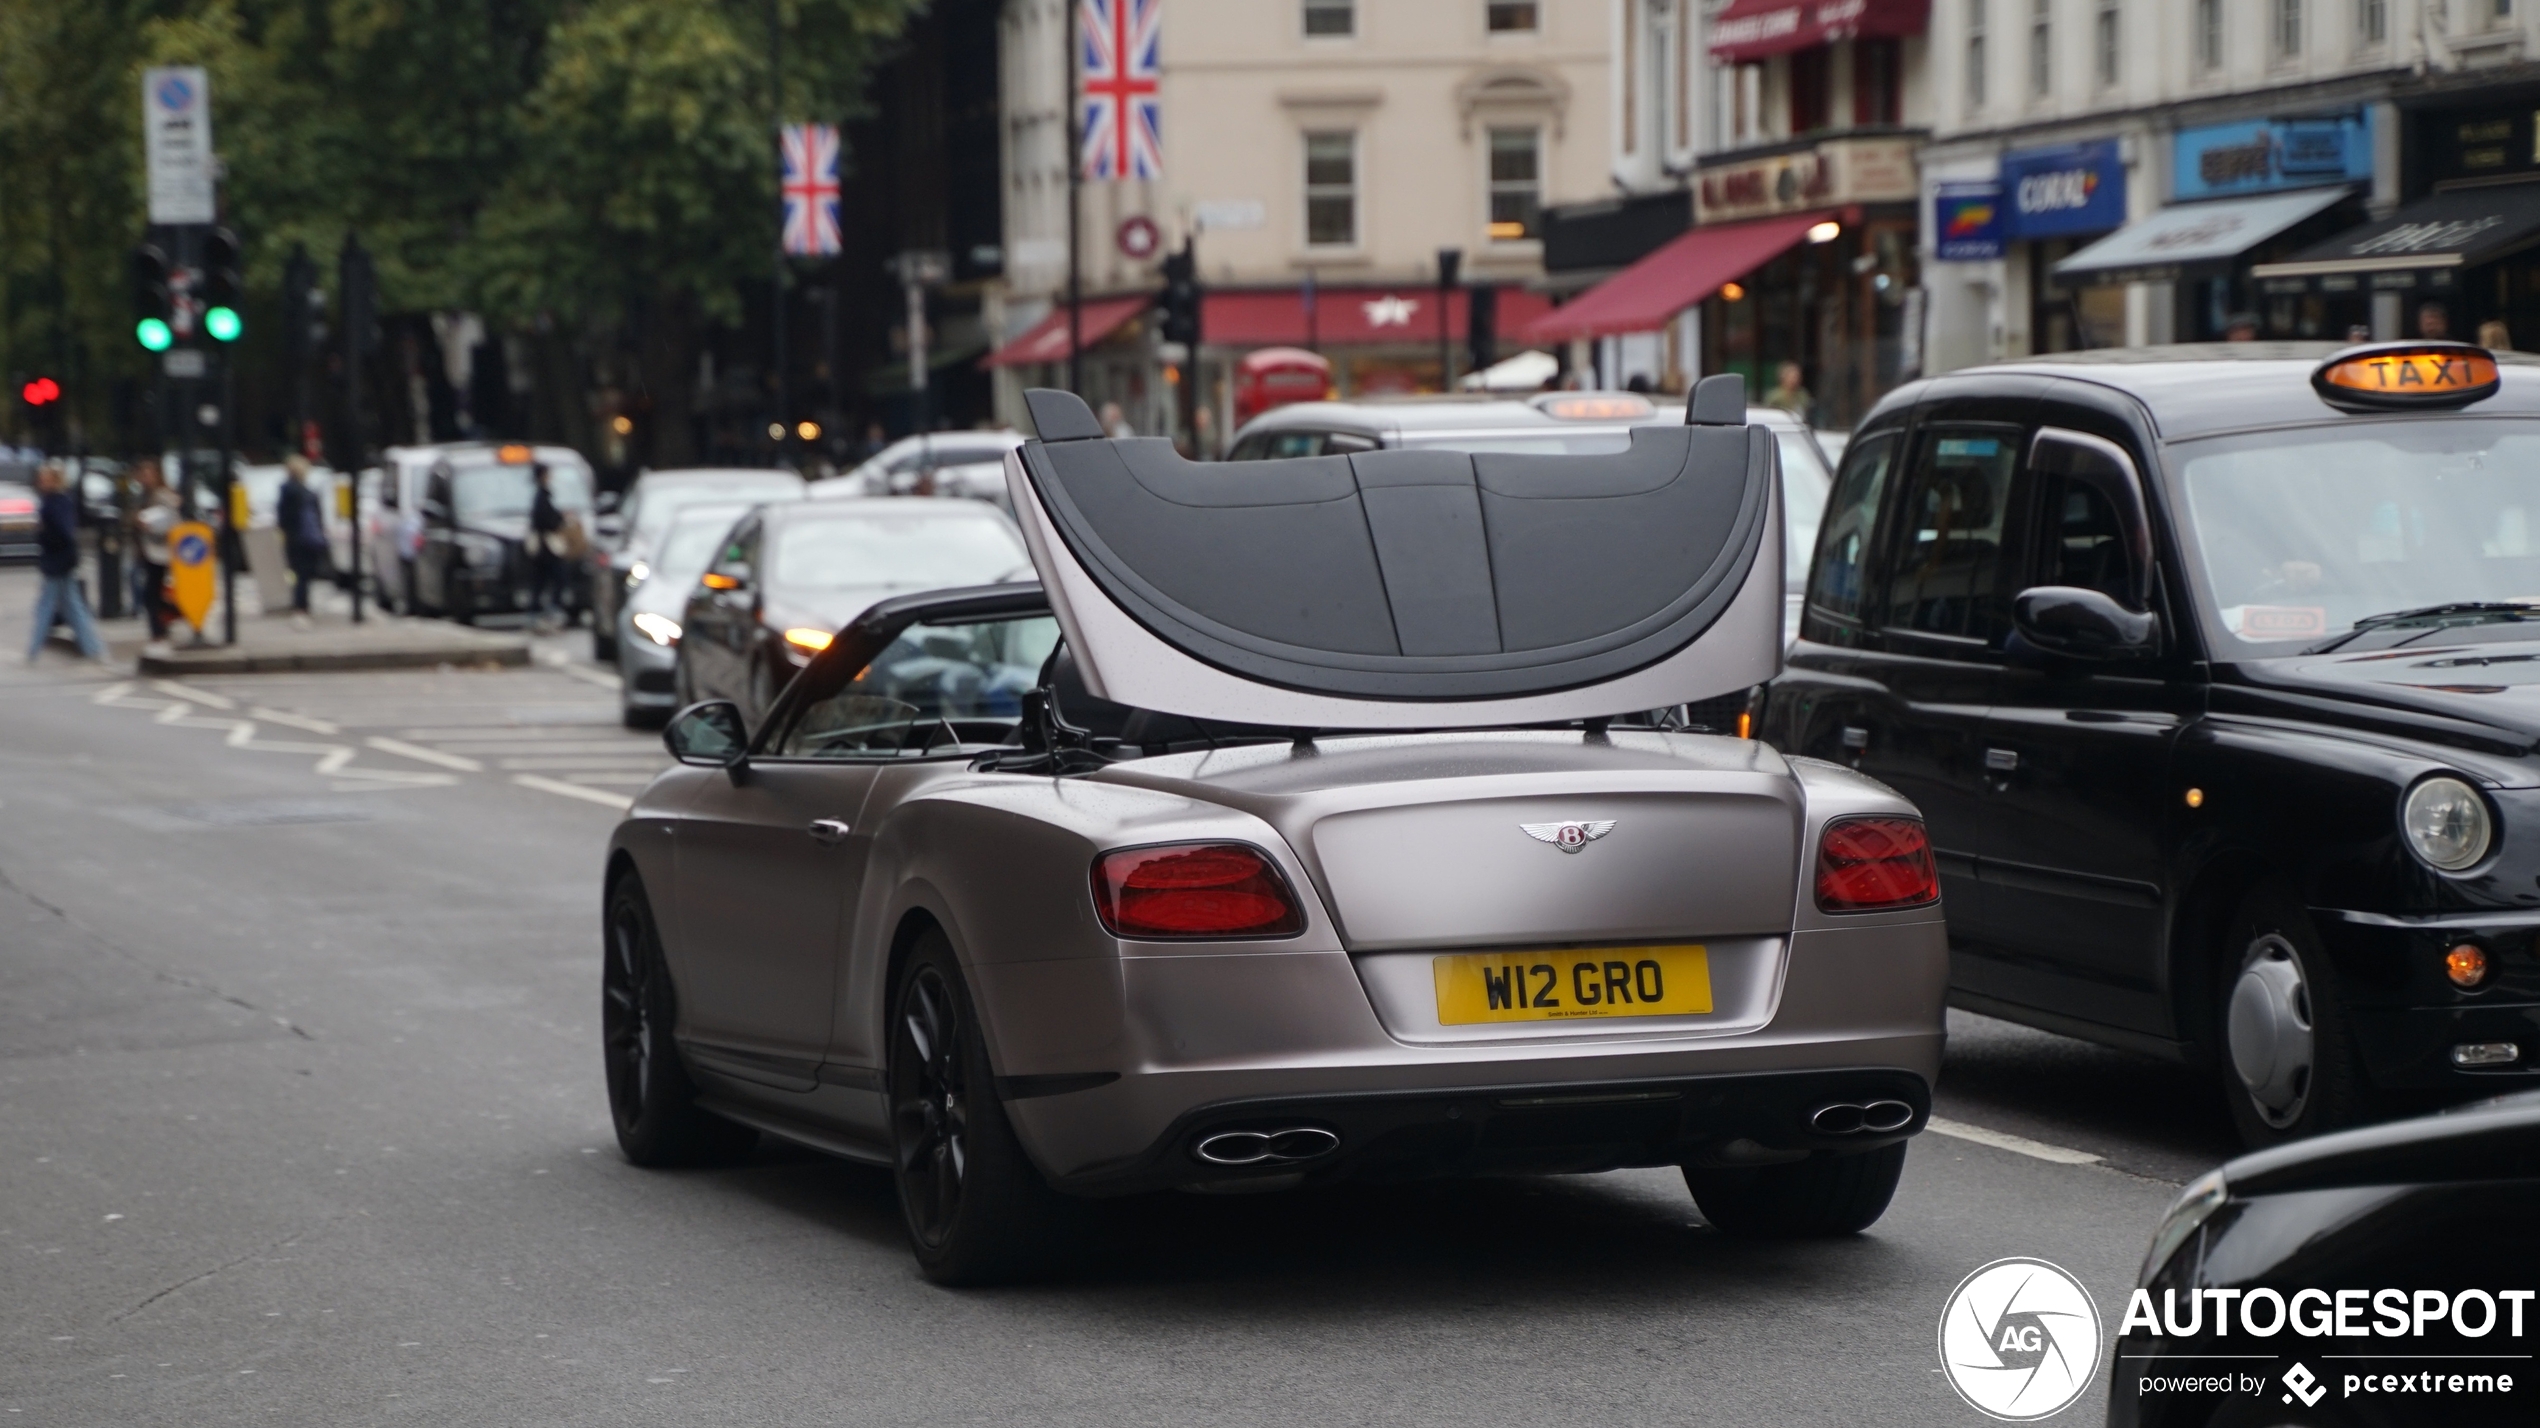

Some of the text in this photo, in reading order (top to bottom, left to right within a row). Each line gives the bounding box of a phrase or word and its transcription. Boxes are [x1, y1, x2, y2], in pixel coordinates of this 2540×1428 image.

[2369, 358, 2473, 387] TAXI
[1484, 960, 1664, 1010] W12 GRO
